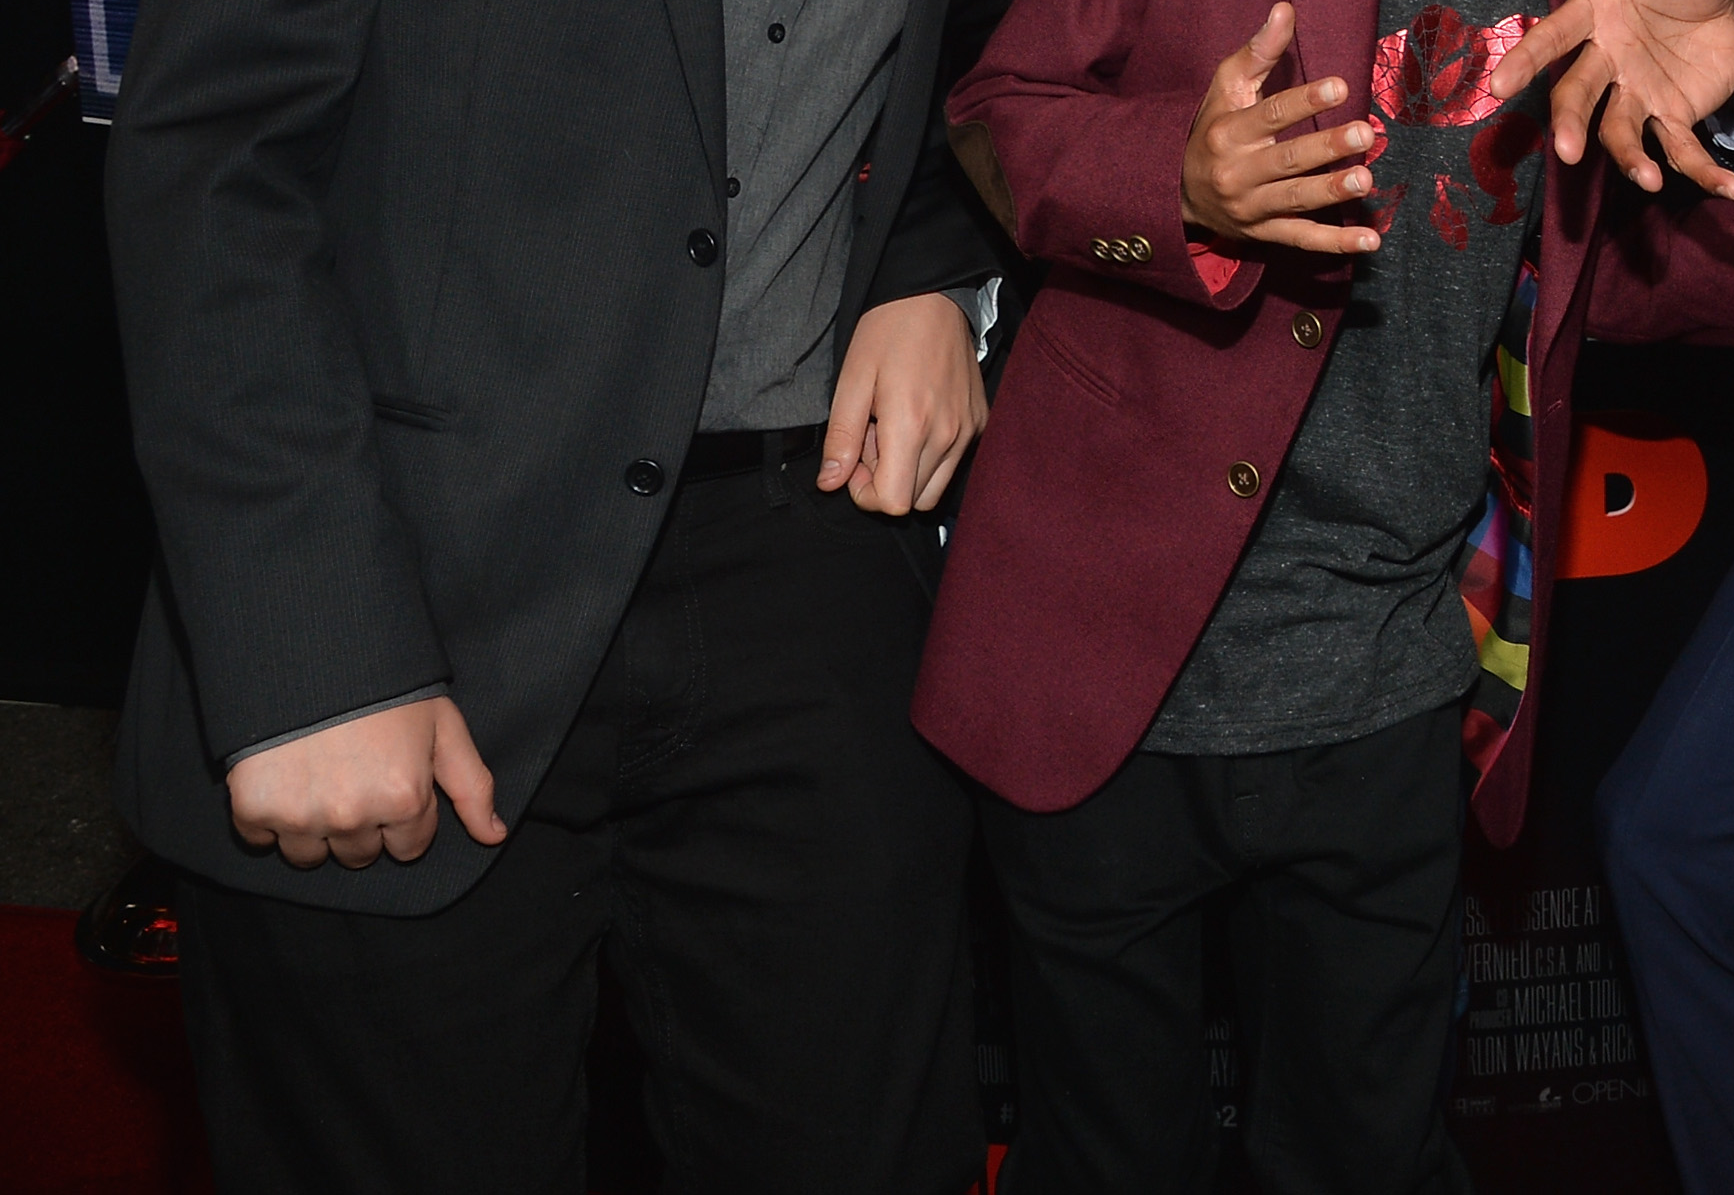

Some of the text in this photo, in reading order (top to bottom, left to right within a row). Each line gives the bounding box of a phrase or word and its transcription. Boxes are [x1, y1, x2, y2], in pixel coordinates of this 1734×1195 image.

[1576, 942, 1601, 973] AND
[1515, 981, 1586, 1026] MICHAEL
[1514, 1027, 1584, 1072] WAYANS
